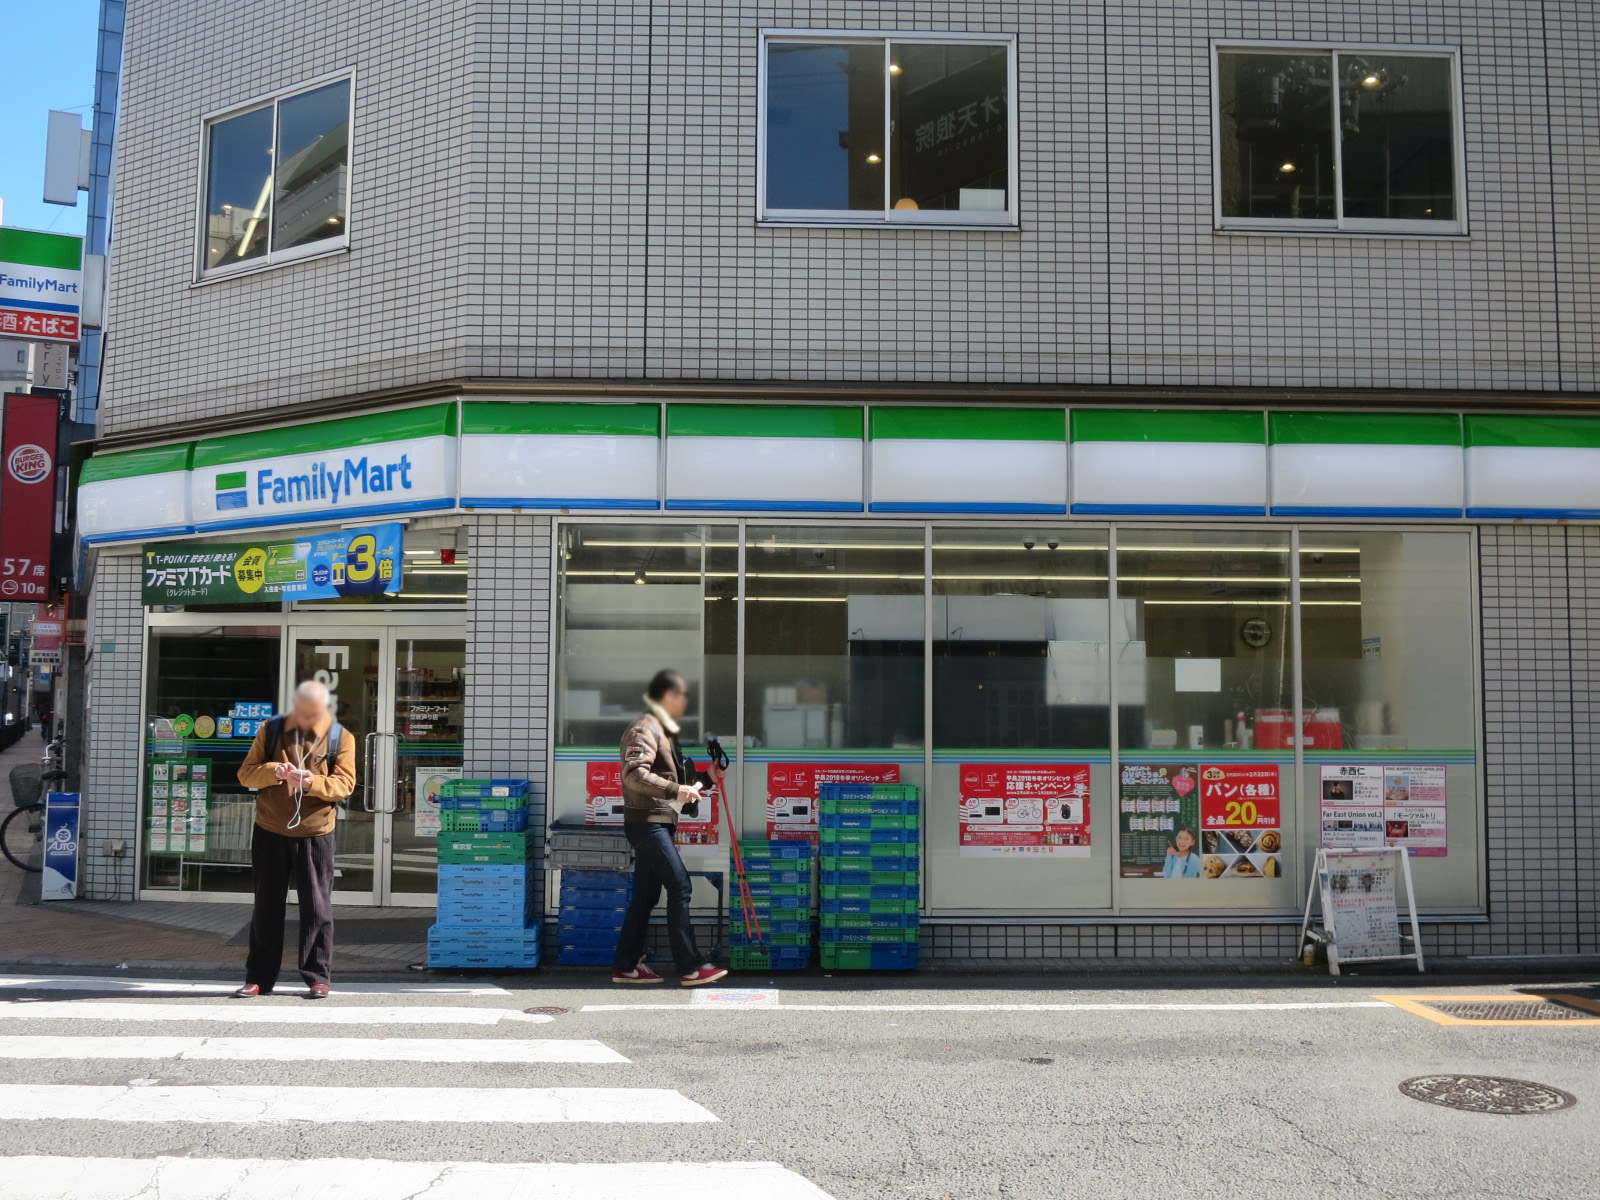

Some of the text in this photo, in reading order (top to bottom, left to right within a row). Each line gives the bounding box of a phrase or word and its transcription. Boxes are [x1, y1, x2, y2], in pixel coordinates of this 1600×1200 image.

[0, 274, 78, 293] FamilyMart
[0, 312, 76, 336] 酒・たばこ
[15, 453, 45, 465] BURGER
[15, 459, 46, 473] KING
[257, 453, 412, 505] FamilyMart
[156, 554, 190, 564] T-POINT
[242, 556, 261, 566] 会員
[347, 534, 393, 581] 3 倍
[3, 558, 46, 576] 57席
[146, 565, 232, 587] ファミマTカード
[238, 569, 263, 582] 募集中
[21, 583, 45, 595] 10席
[235, 704, 272, 717] たばこ
[410, 705, 450, 713] ファミリーマート
[1339, 767, 1366, 776] 赤西仁
[1006, 781, 1072, 791] 応援キャンペーン
[1206, 782, 1275, 798] パン(各種)
